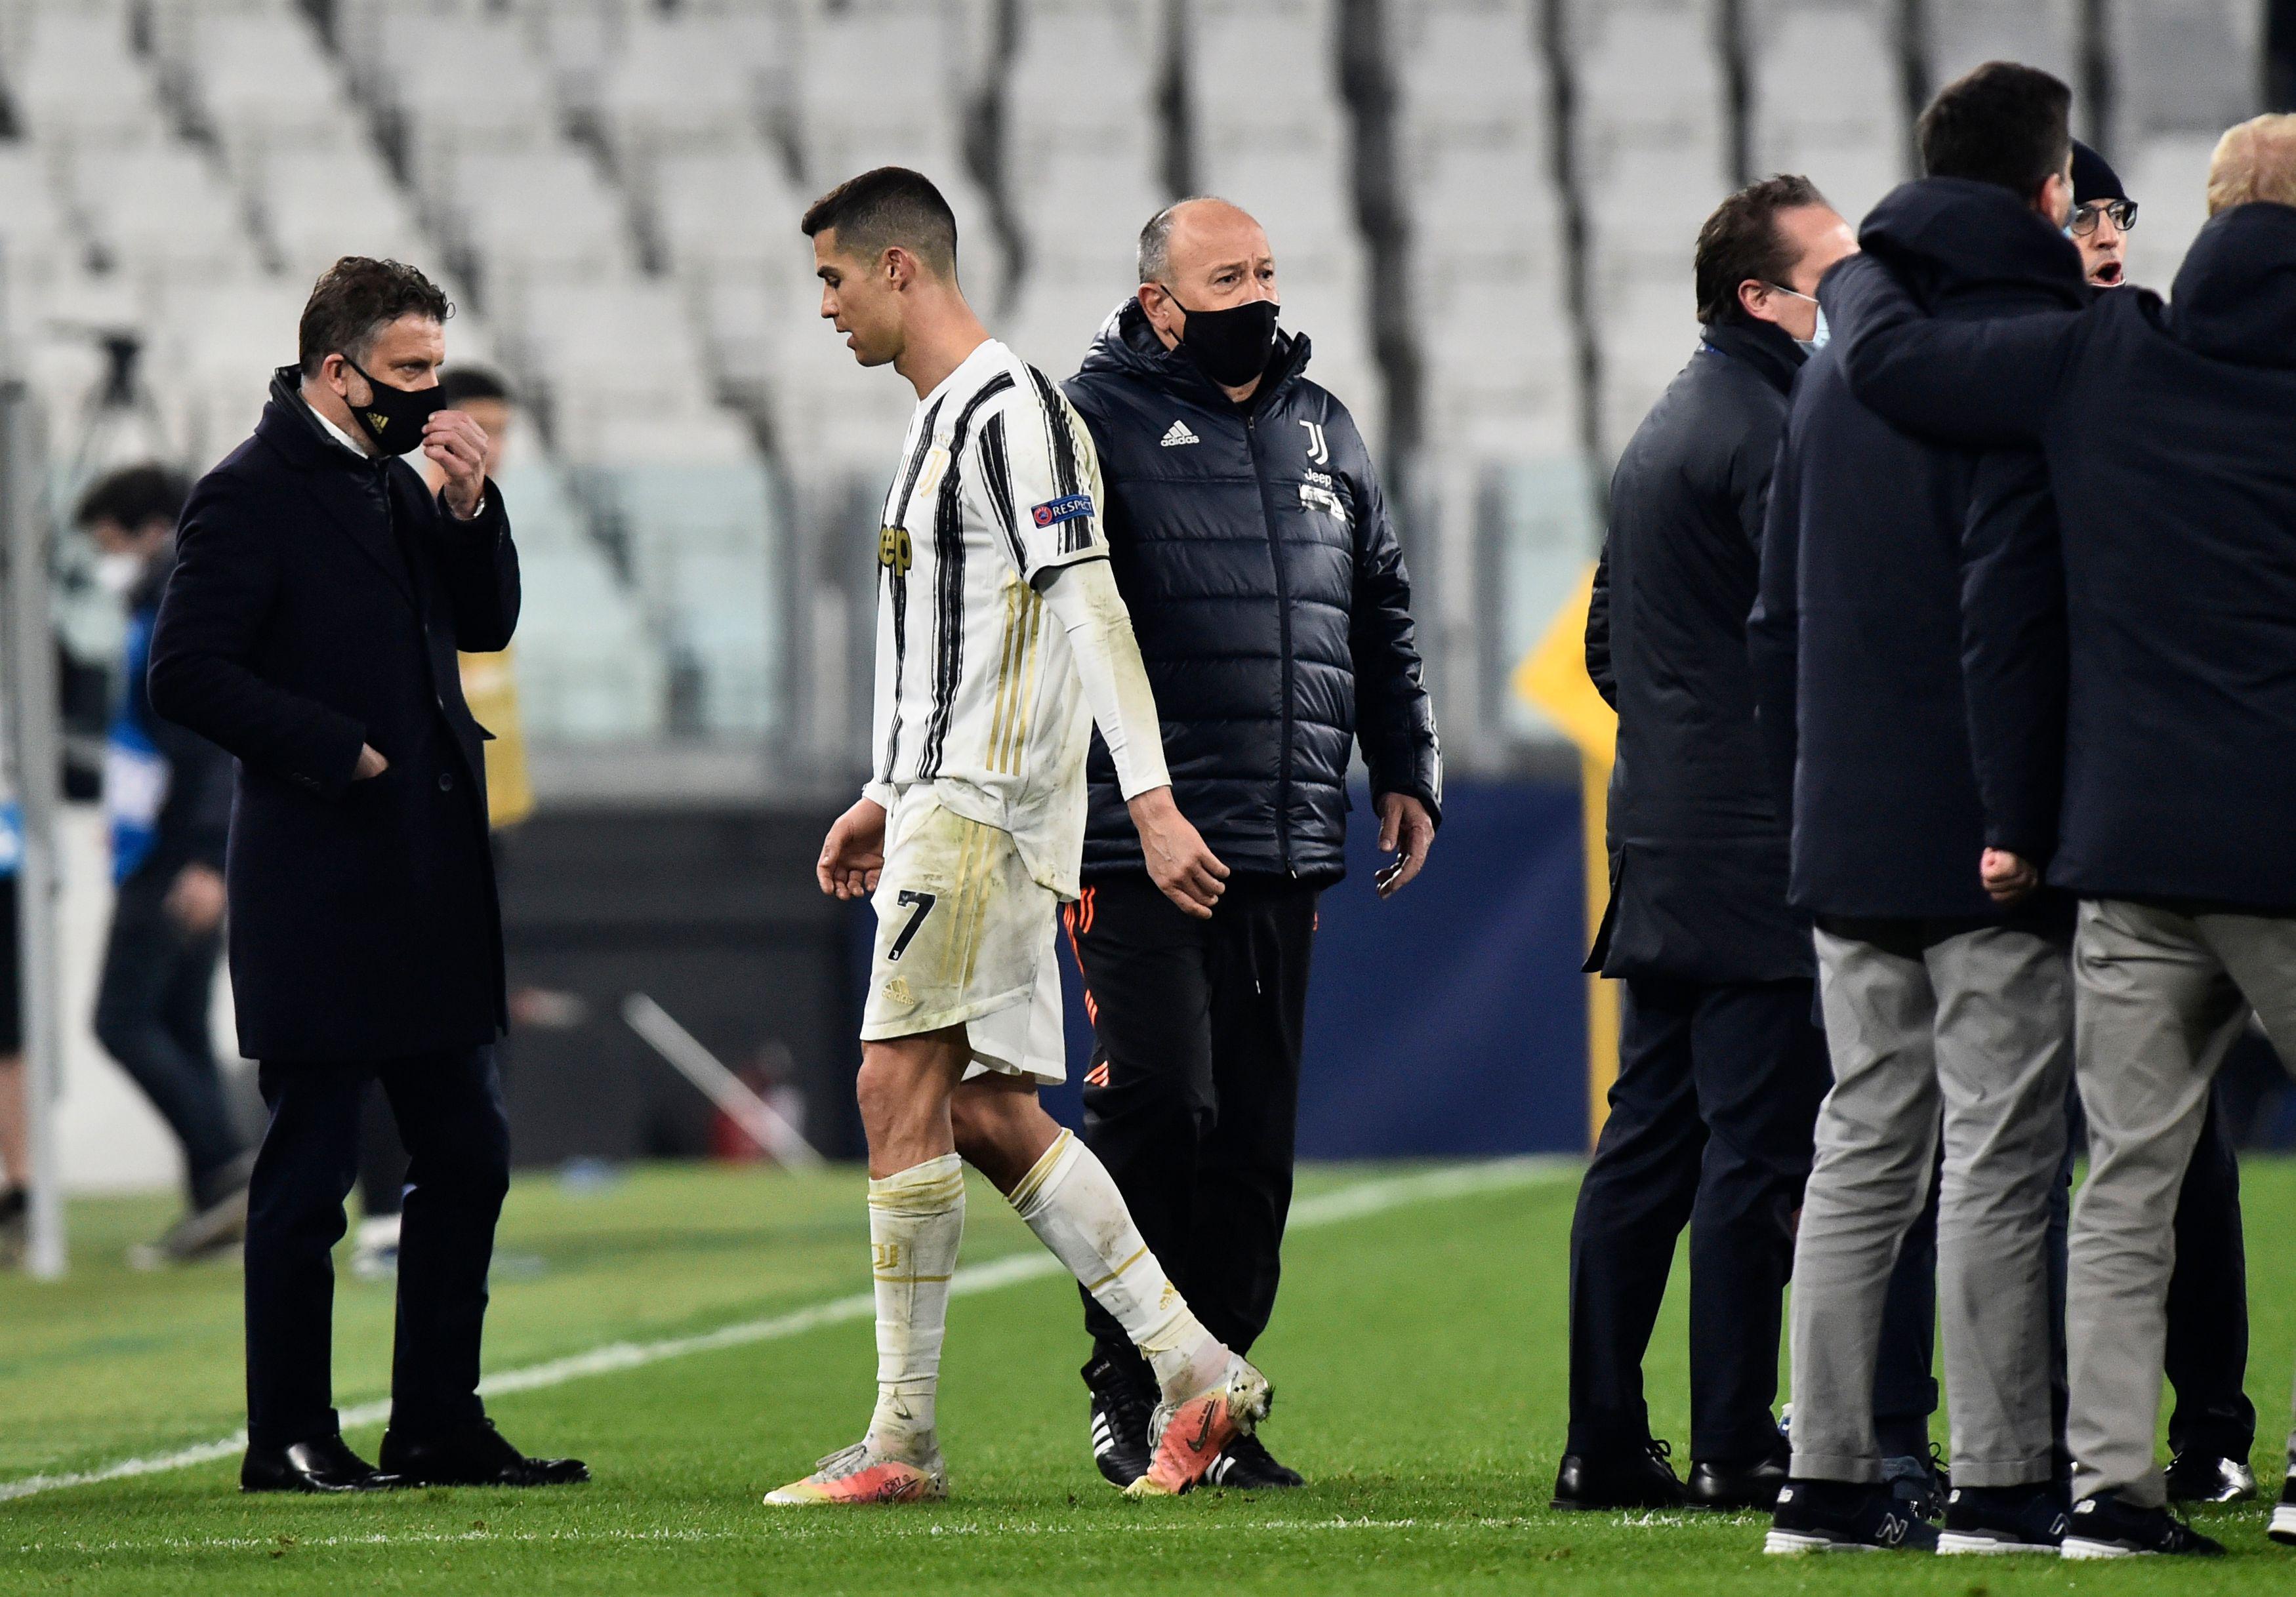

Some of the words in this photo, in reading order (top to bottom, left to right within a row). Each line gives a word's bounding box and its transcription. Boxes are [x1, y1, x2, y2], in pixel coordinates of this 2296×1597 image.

[1160, 434, 1200, 447] adidas
[1305, 468, 1332, 487] Jeep
[888, 889, 937, 961] 7
[1875, 1512, 1909, 1545] N
